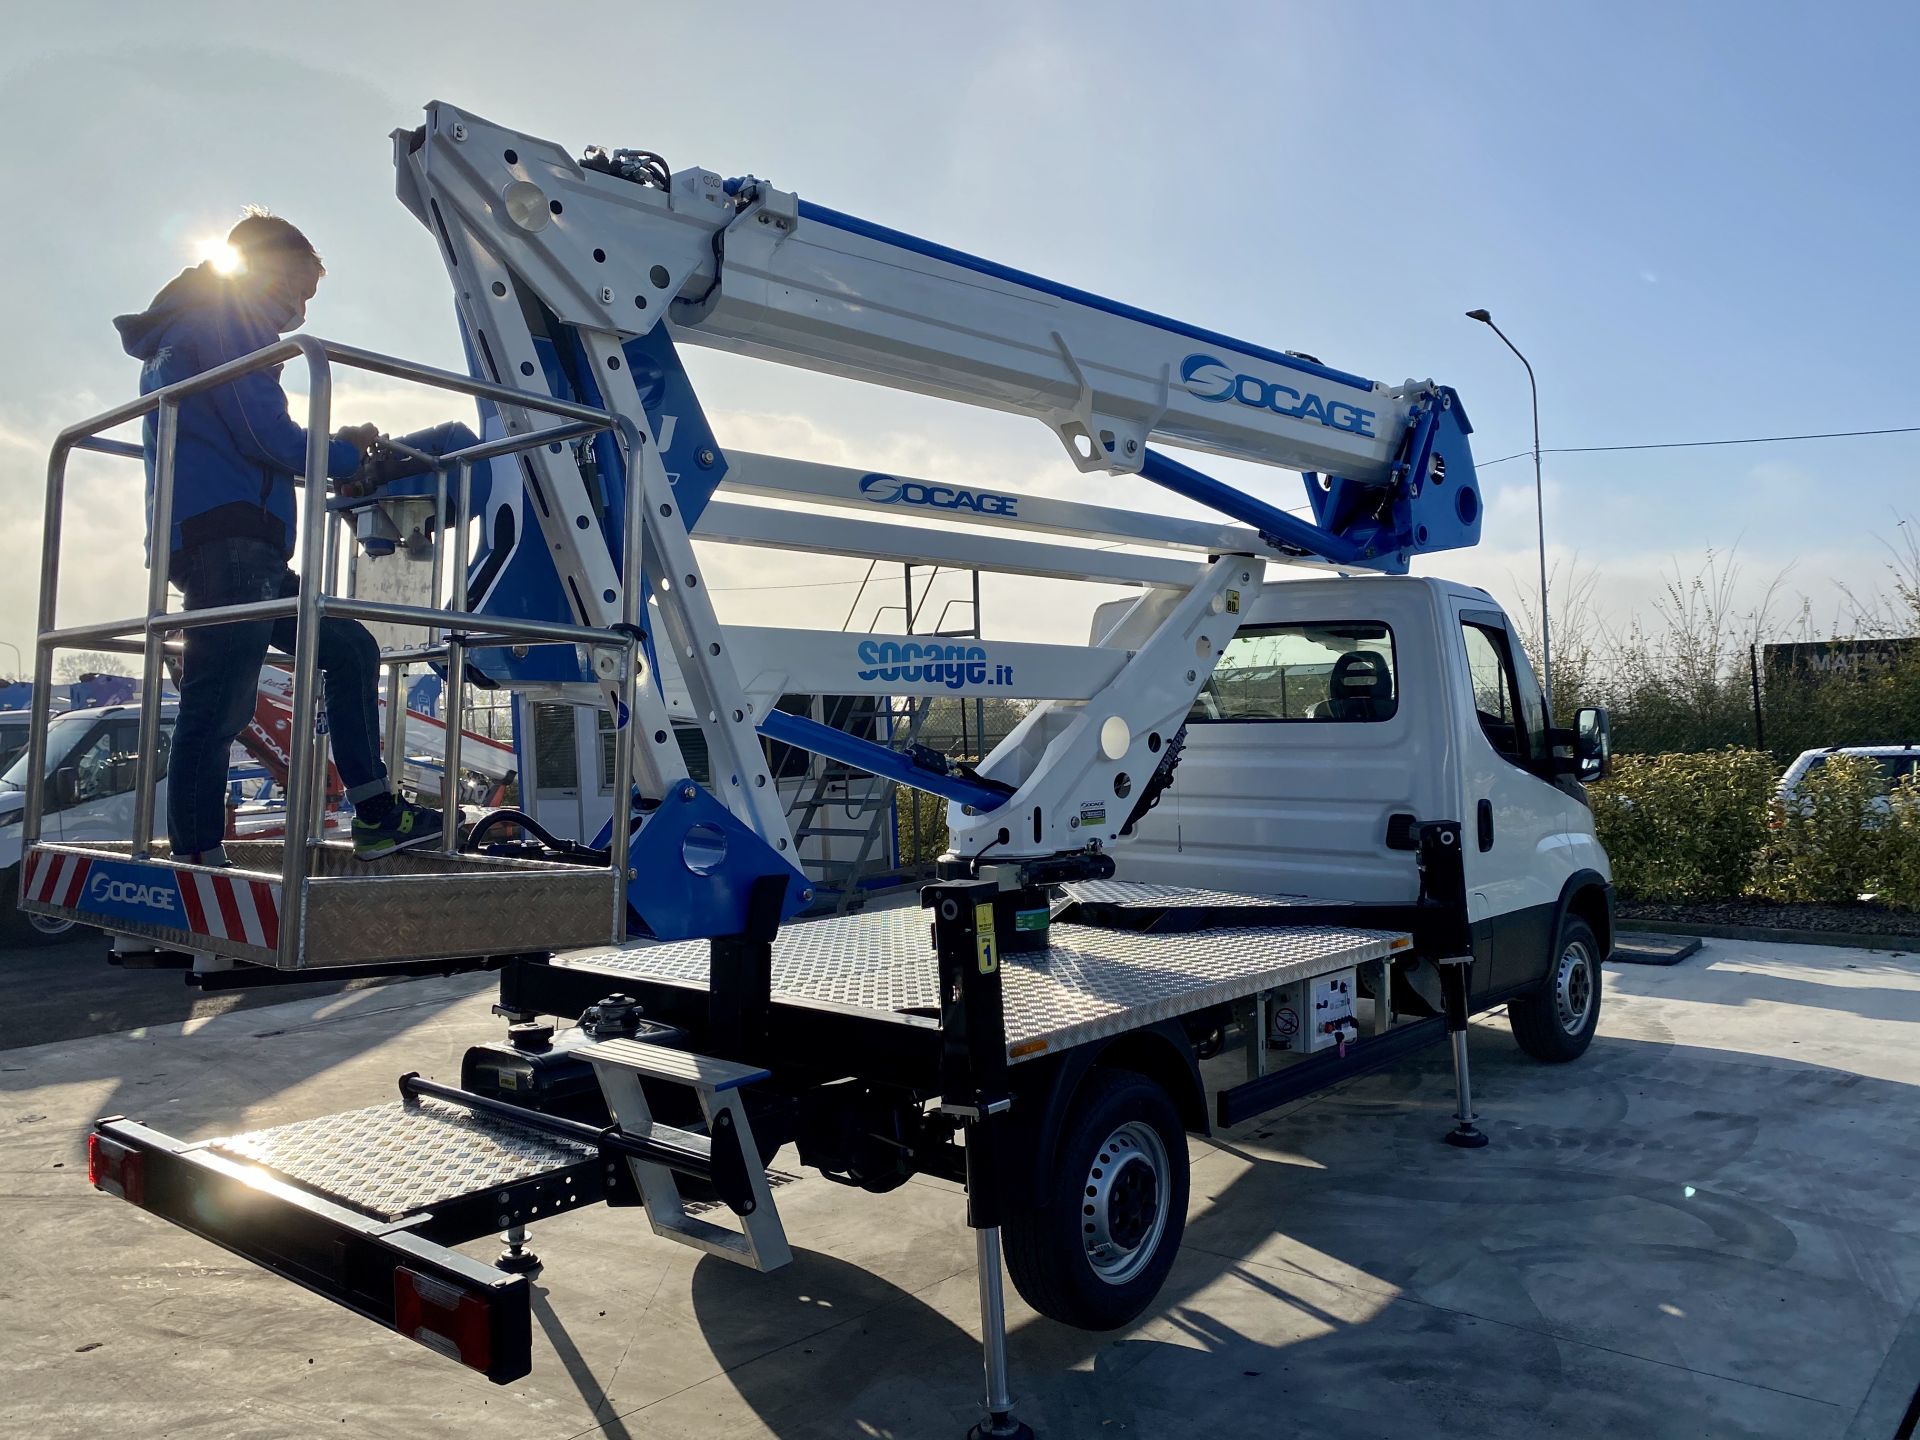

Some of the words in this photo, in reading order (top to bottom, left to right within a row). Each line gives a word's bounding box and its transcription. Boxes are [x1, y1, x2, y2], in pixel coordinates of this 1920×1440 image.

[1180, 353, 1375, 438] SOCAGE
[859, 473, 1017, 516] SOCAGE
[858, 640, 1013, 689] socage.it
[91, 872, 175, 911] SOCAGE
[983, 944, 992, 966] 1
